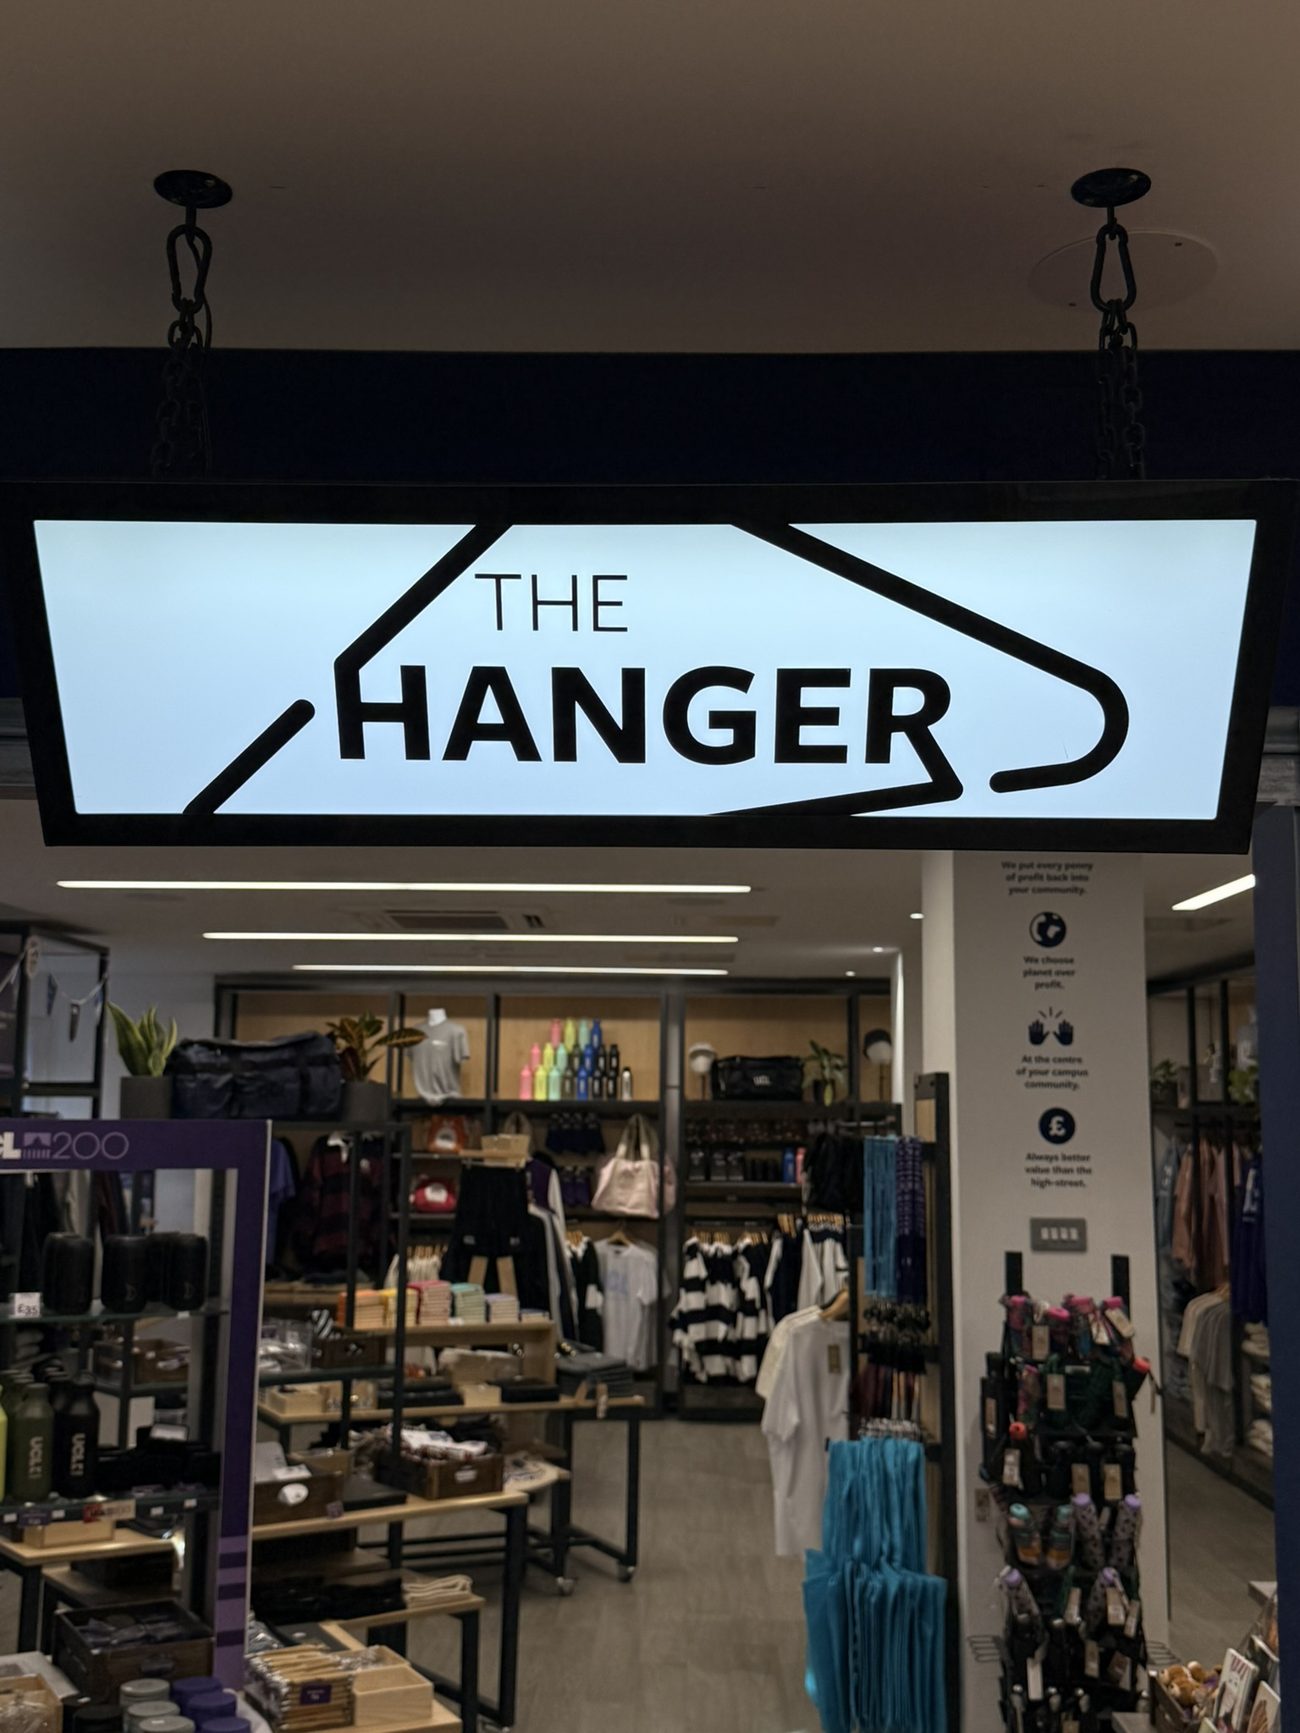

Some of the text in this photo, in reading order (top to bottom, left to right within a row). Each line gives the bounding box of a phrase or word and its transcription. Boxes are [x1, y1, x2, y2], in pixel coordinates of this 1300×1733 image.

[475, 573, 629, 632] THE
[337, 663, 951, 767] HANGER
[1001, 861, 1017, 870] We
[1018, 862, 1034, 871] put
[1036, 862, 1062, 872] every
[1005, 872, 1016, 881] of
[1018, 872, 1044, 884] profit
[1046, 873, 1068, 881] back
[1008, 886, 1029, 896] your
[1024, 956, 1074, 964] We choose
[1023, 968, 1052, 978] planet
[1022, 1055, 1082, 1064] At the centre
[1016, 1067, 1026, 1076] of
[1028, 1069, 1049, 1078] your
[51, 1131, 130, 1160] 200
[1026, 1152, 1059, 1164] Always
[1076, 1166, 1092, 1174] the
